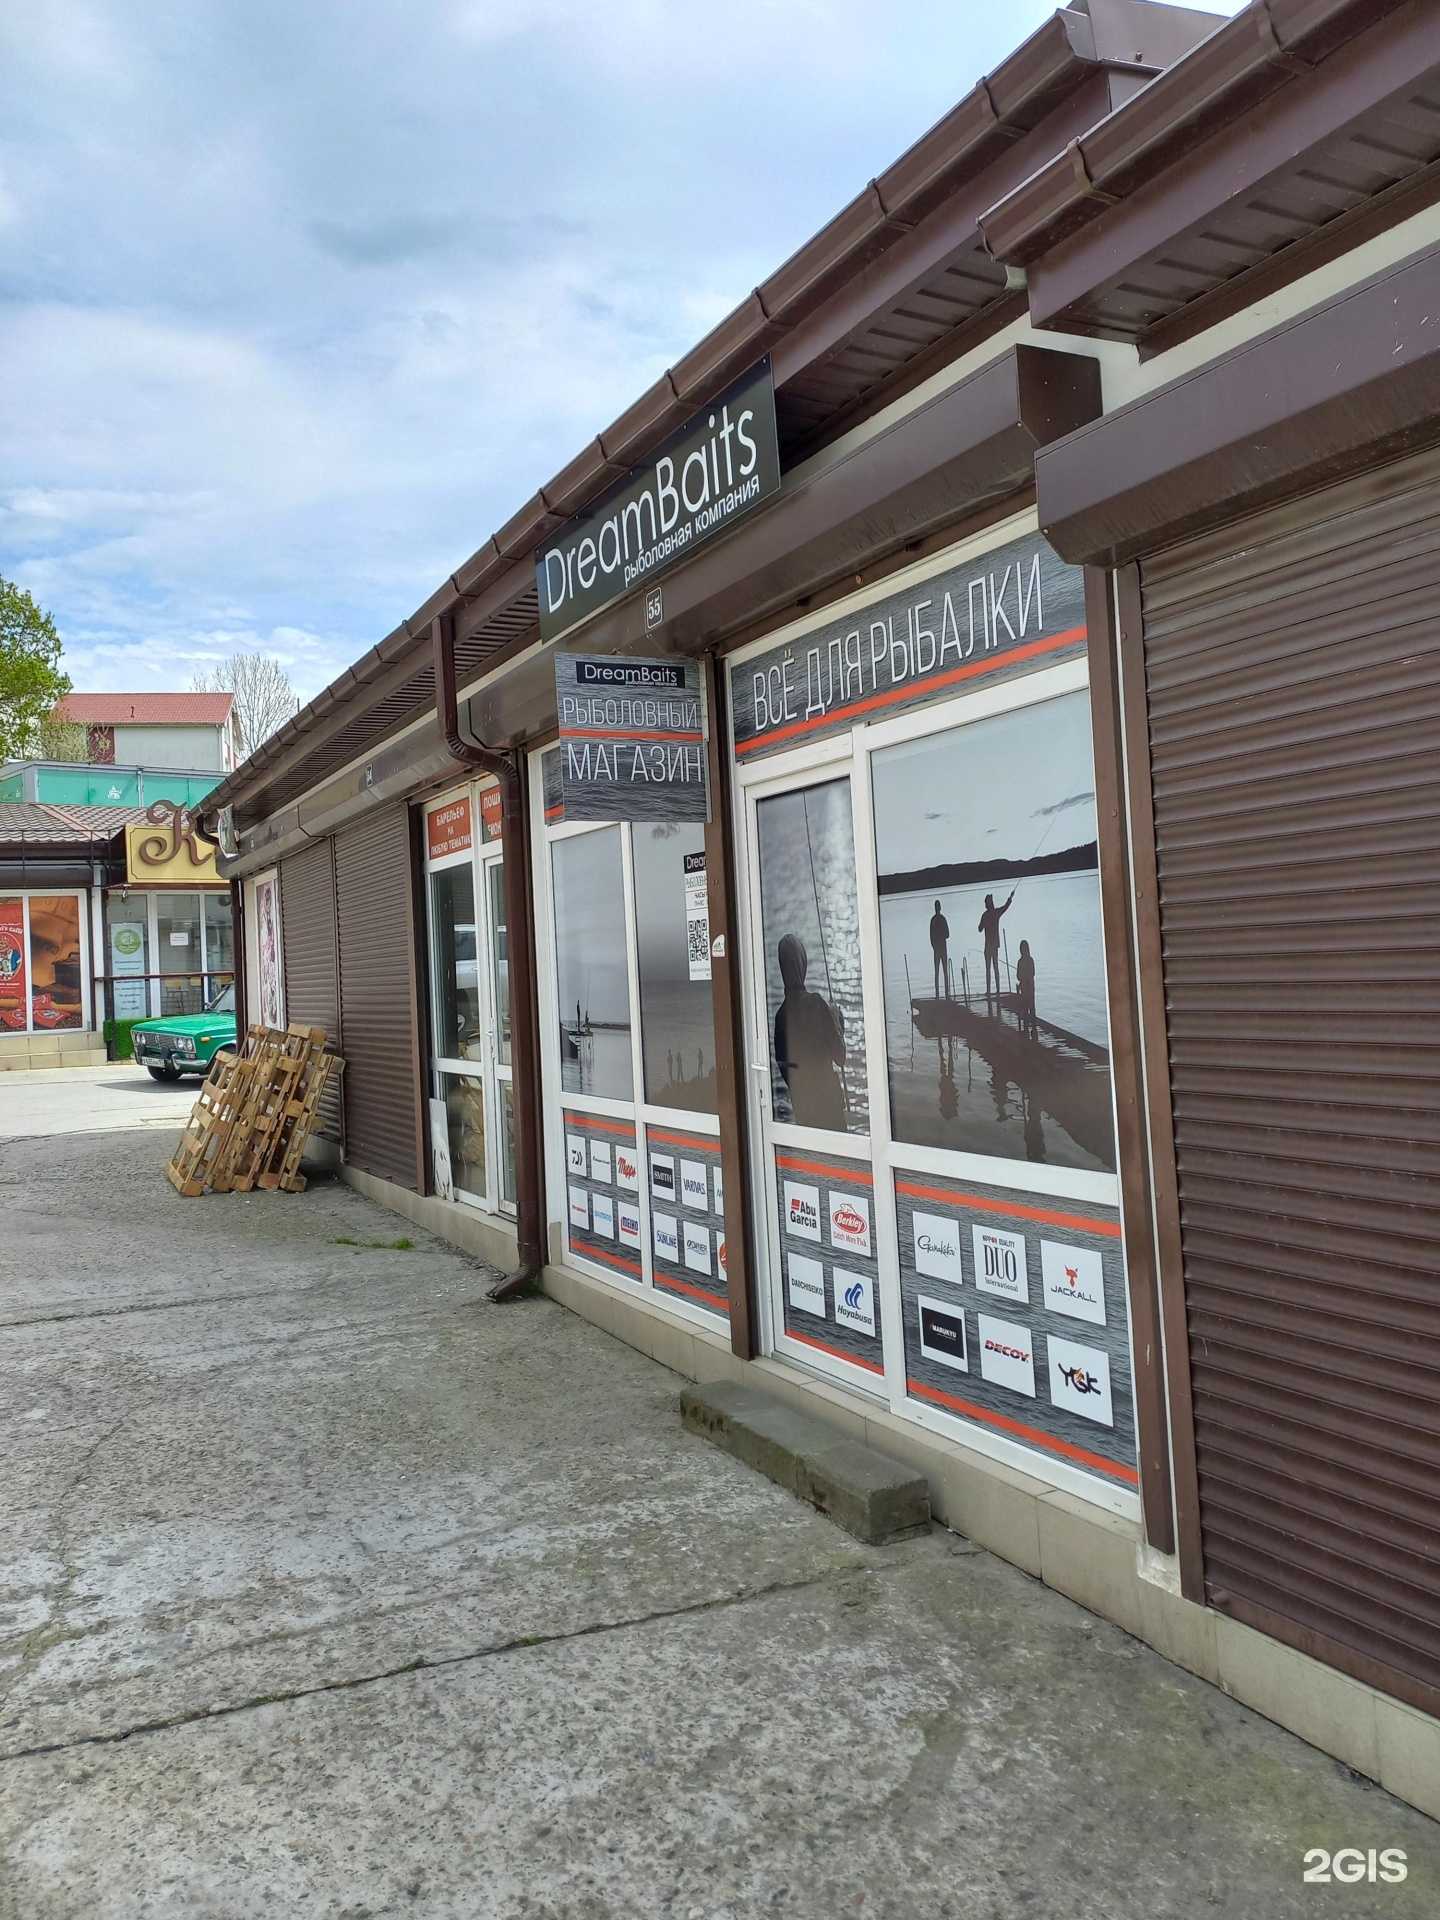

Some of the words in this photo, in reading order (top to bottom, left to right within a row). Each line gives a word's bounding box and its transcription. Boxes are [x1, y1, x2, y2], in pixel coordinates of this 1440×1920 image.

[544, 405, 758, 614] DreamBaits
[623, 520, 694, 587] рыболовная
[694, 474, 761, 536] компания
[647, 597, 662, 621] 55
[753, 650, 798, 732] ВСЁ
[805, 630, 864, 721] ДЛЯ
[870, 553, 1045, 690] РЫБАЛКИ
[584, 664, 678, 683] DreamBaits
[562, 697, 698, 728] РЫБОЛОВНЫЙ
[567, 743, 702, 783] МАГАЗИН
[686, 855, 708, 869] Drea
[654, 1171, 673, 1184] SMITH
[800, 1200, 817, 1216] Abu
[790, 1210, 817, 1229] Garcia
[837, 1213, 863, 1231] Berkley
[983, 1244, 1018, 1283] DUO
[1050, 1284, 1097, 1304] JACKALL
[837, 1303, 873, 1325] Hayabusa
[932, 1324, 957, 1338] MARUKYU
[984, 1339, 1030, 1362] DECOY
